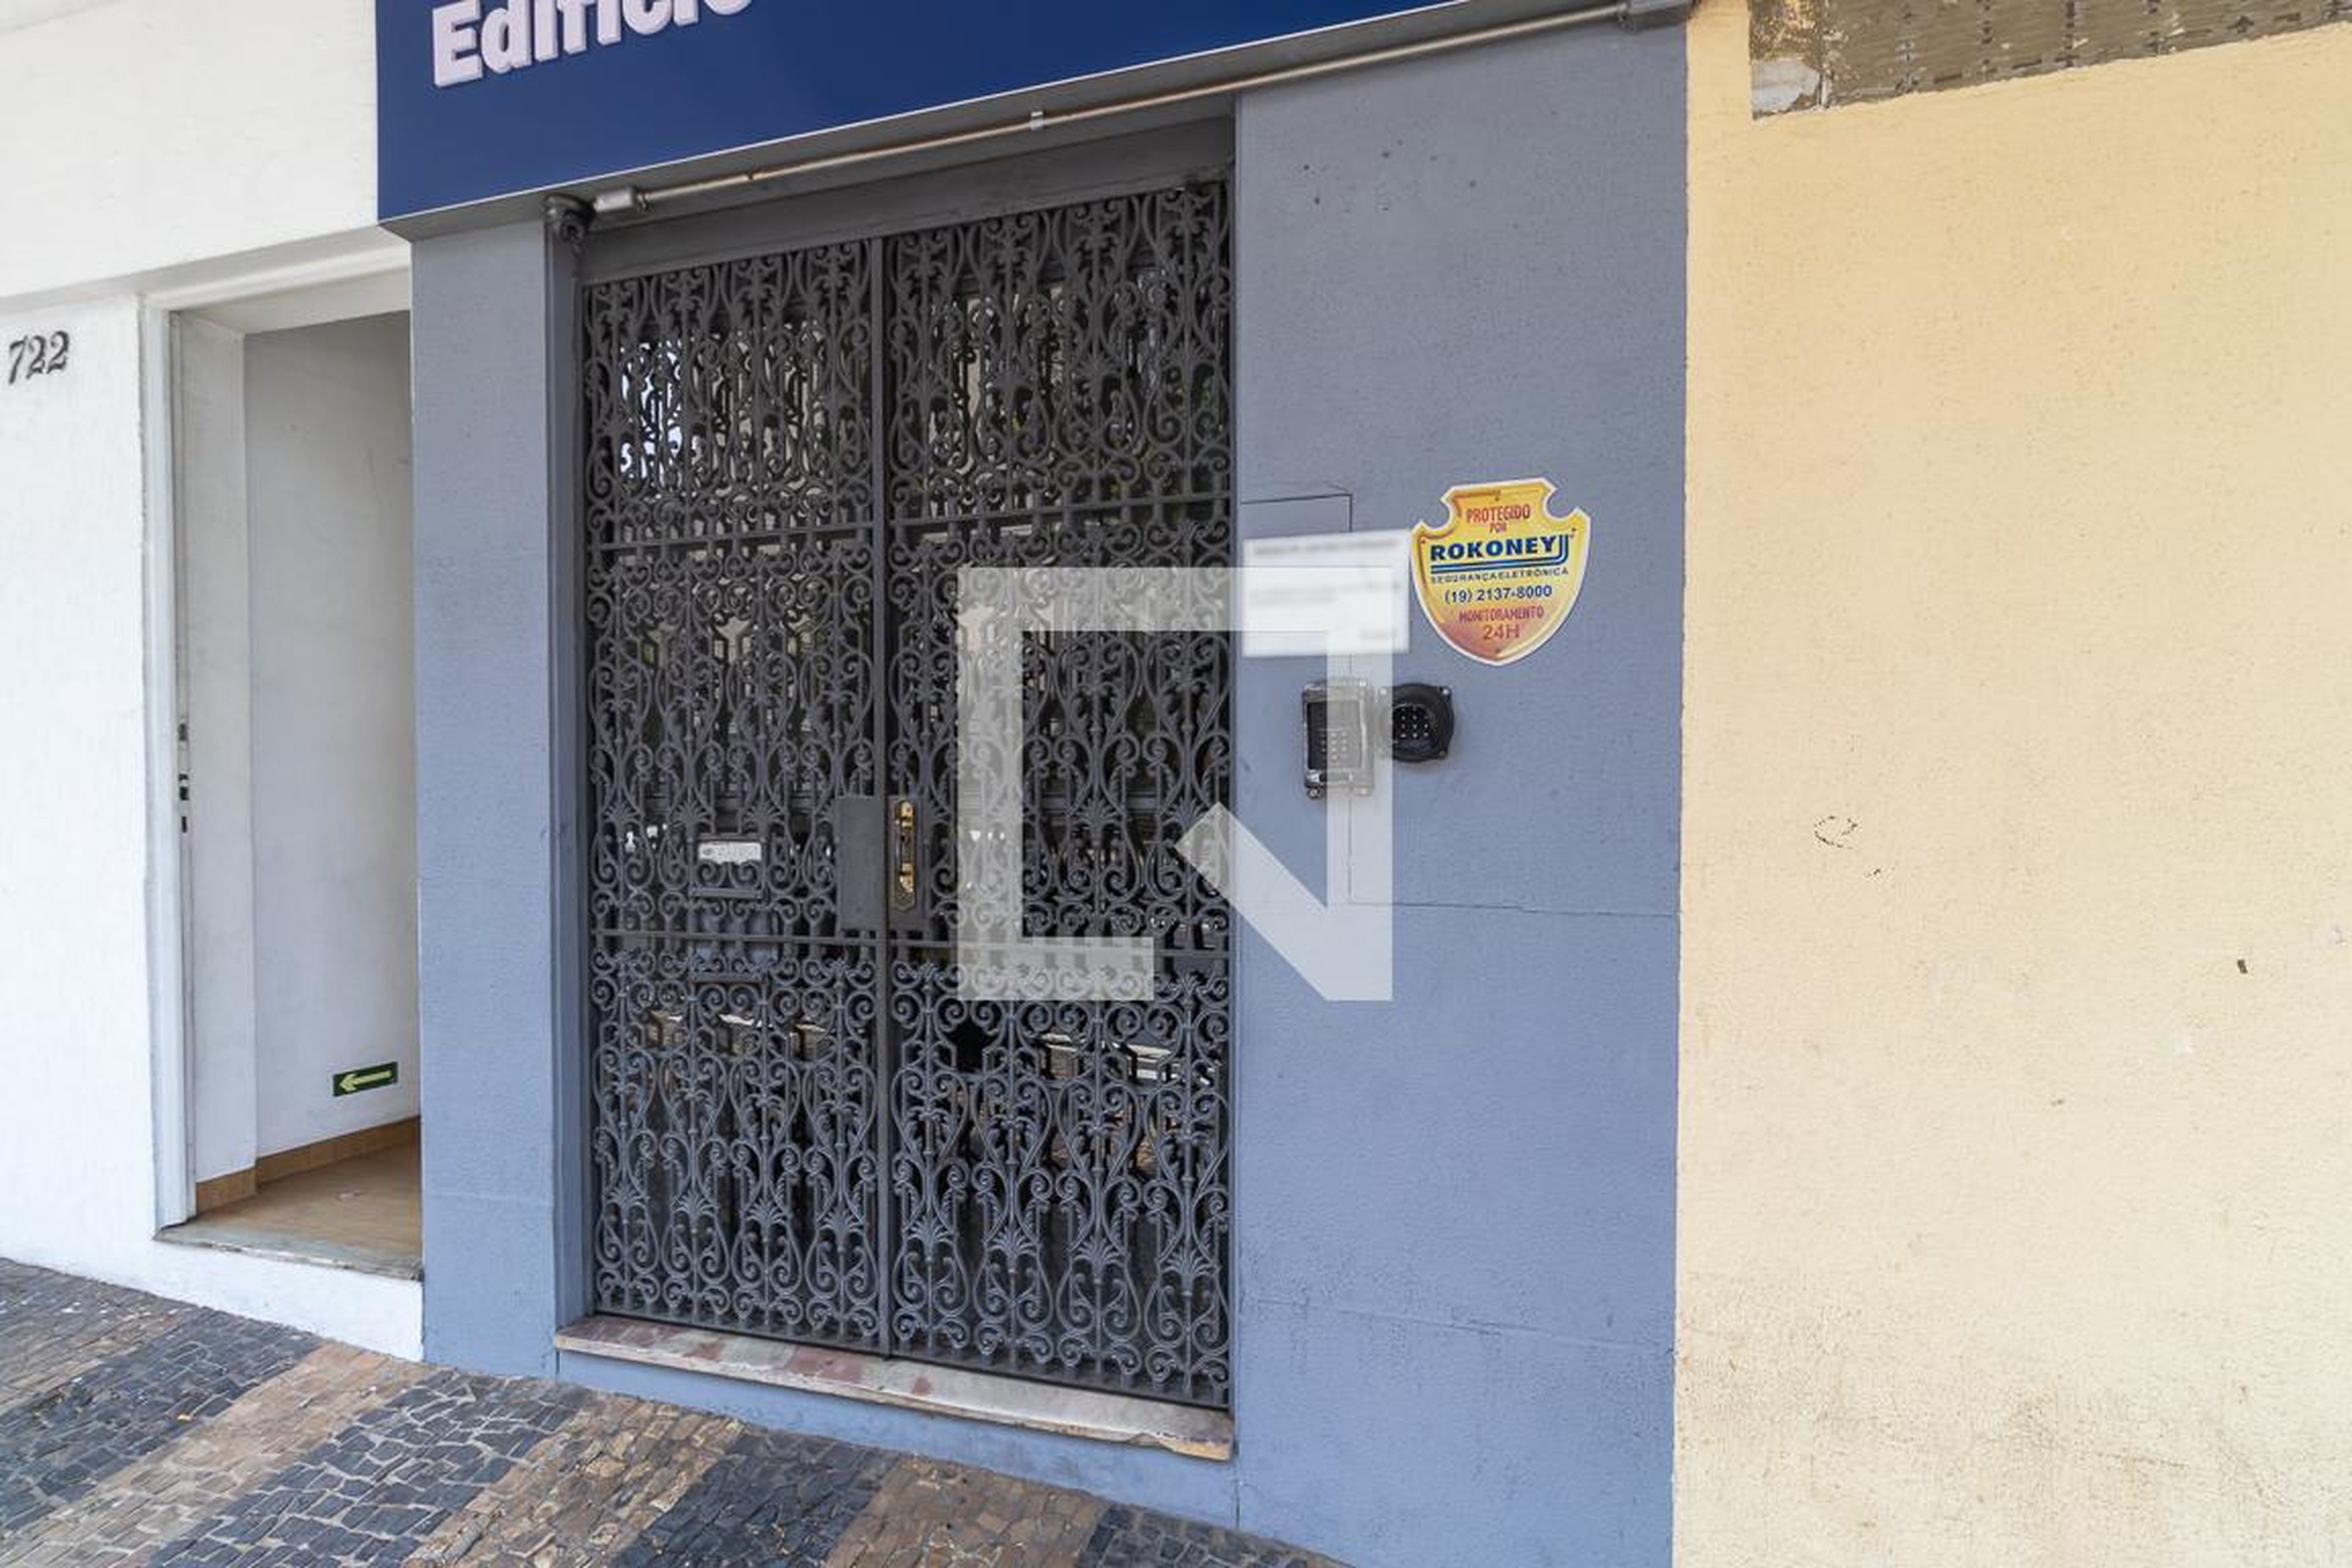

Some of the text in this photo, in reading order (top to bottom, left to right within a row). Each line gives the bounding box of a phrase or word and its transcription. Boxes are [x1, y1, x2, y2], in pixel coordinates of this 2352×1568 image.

[9, 330, 70, 384] 722
[1466, 504, 1531, 523] PROTEGIDO
[1489, 522, 1508, 533] POR
[1430, 537, 1556, 560] ROKONEY
[1445, 585, 1552, 605] (19) 2137-8000
[1459, 605, 1545, 622] MONITORAMENTO
[1483, 624, 1520, 641] 24H
